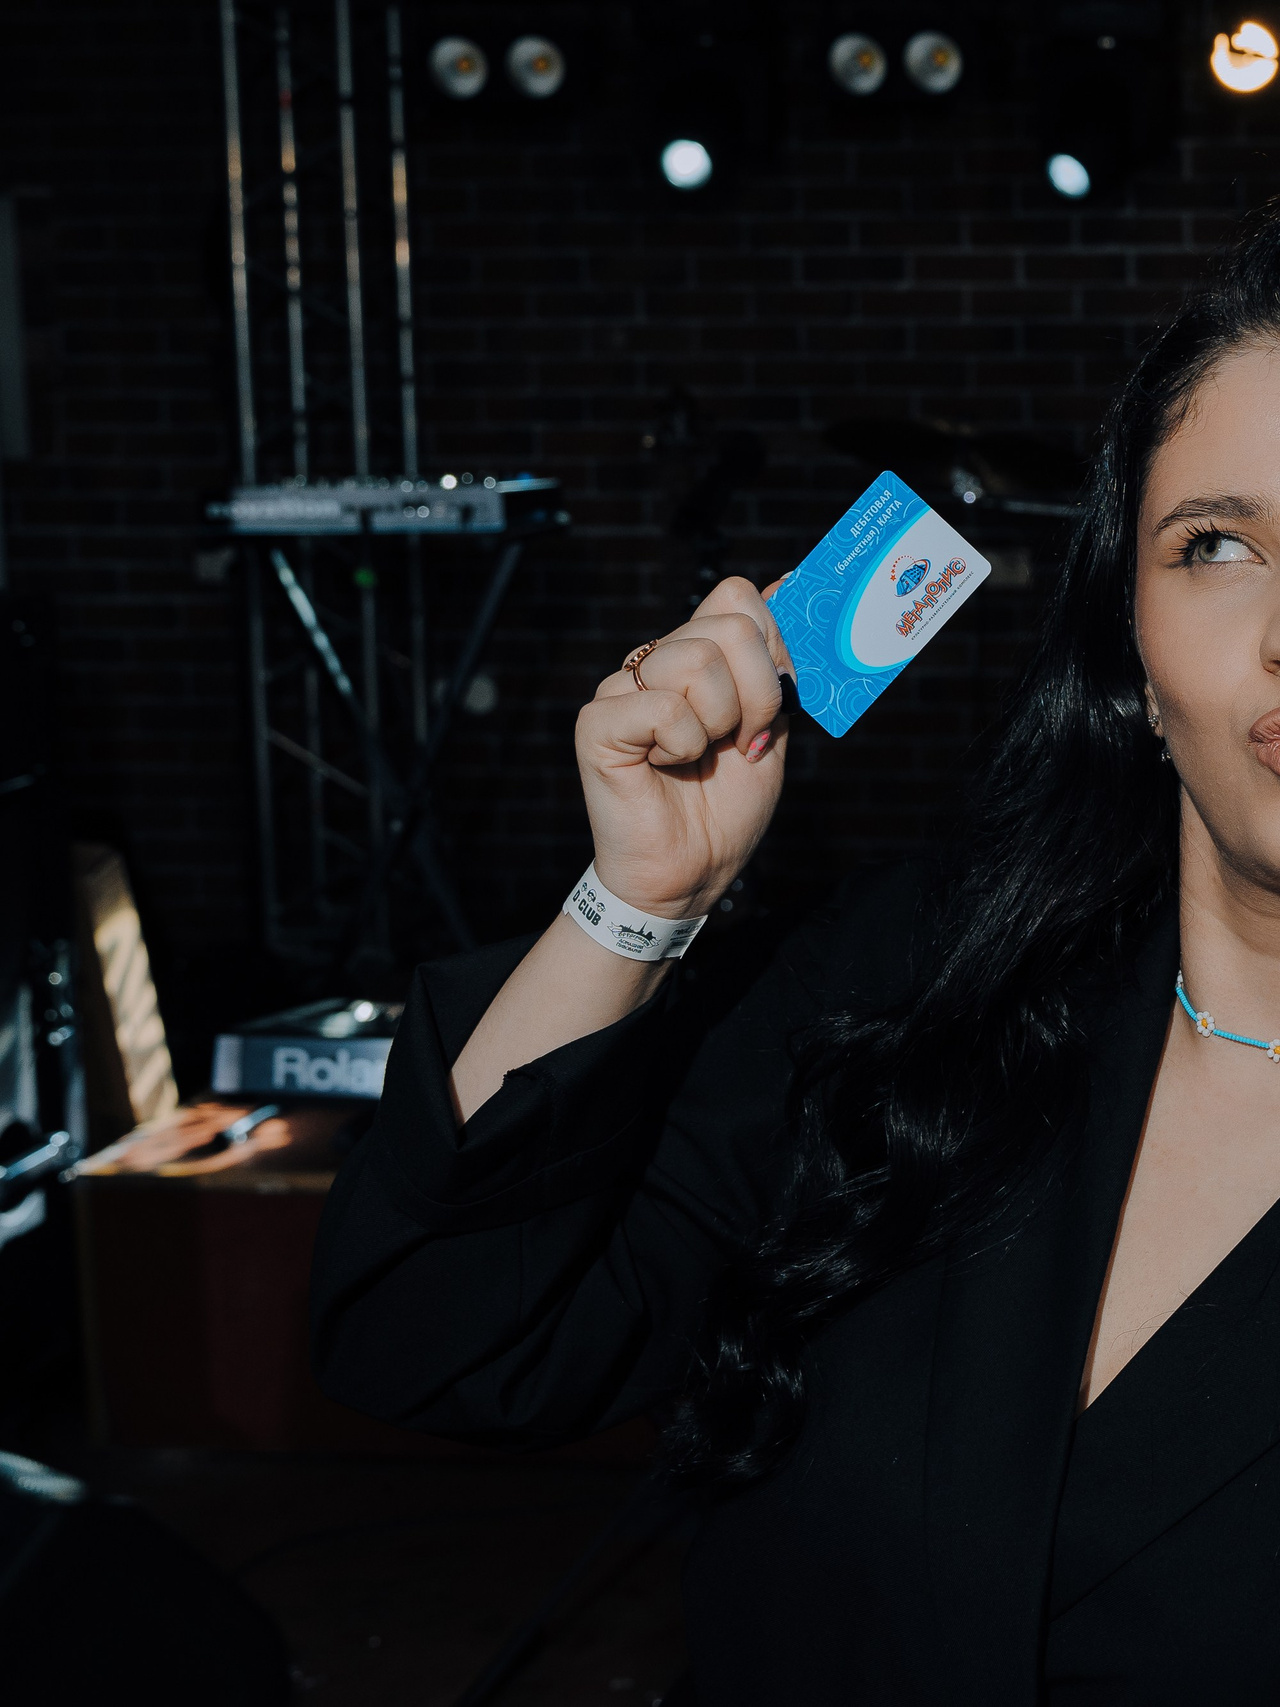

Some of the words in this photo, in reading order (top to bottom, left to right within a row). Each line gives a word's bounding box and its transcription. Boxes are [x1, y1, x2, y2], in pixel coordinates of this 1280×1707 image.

[834, 525, 880, 575] (банкетная)
[876, 499, 903, 528] КАРТА
[850, 489, 893, 538] ДЕБЕТОВАЯ
[895, 557, 966, 637] МЕГАПОЛИС
[272, 1046, 387, 1092] Rola
